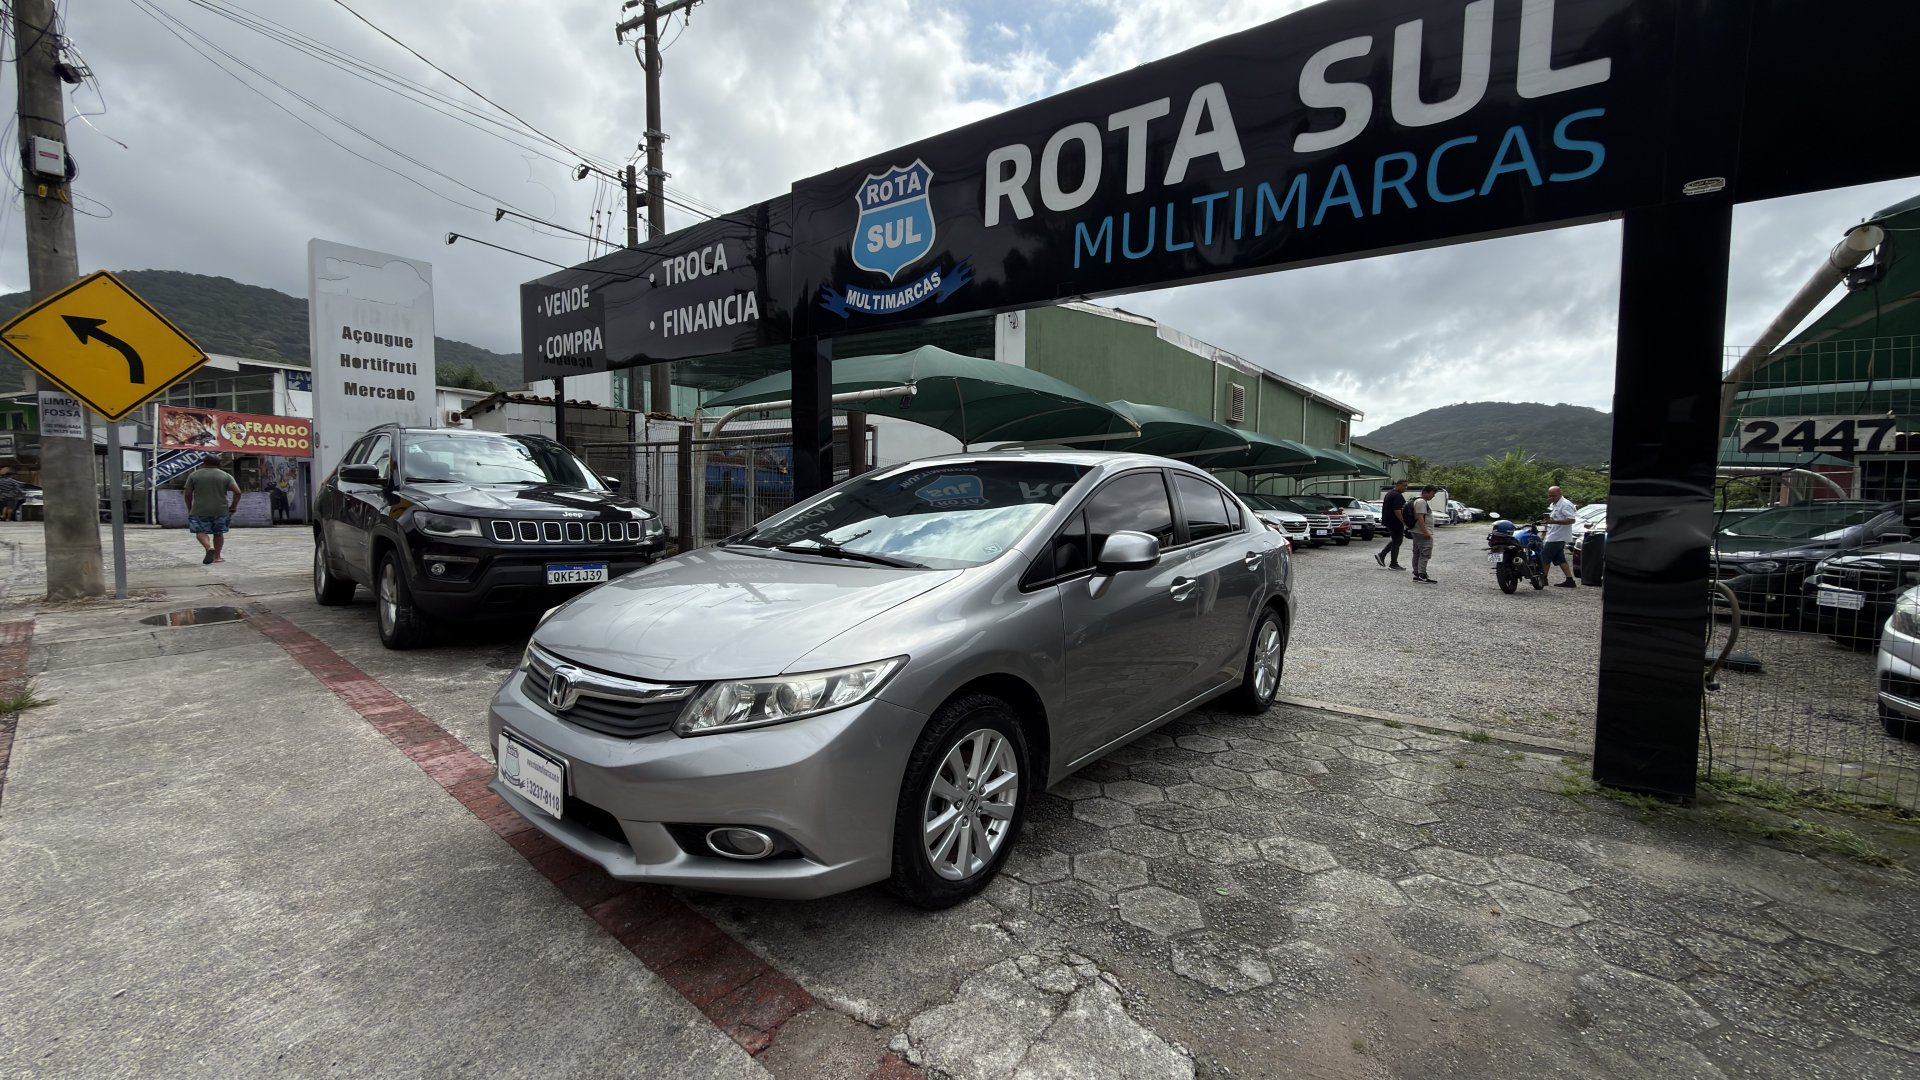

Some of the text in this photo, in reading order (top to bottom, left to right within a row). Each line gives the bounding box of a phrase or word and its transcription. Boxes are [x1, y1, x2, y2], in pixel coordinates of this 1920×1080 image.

[984, 0, 1612, 228] ROTA SUL
[866, 171, 922, 206] ROTA
[1073, 98, 1606, 269] MULTIMARCAS
[867, 216, 922, 253] SUL
[662, 243, 729, 287] TROCA
[544, 284, 590, 318] VENDE
[846, 271, 942, 310] MULTIMARCAS
[663, 290, 760, 338] FINANCIA
[342, 325, 414, 349] Açougue
[546, 326, 603, 359] COMPRA
[340, 353, 417, 376] Hortifruti
[43, 397, 80, 407] LIMPA
[344, 381, 416, 401] Mercado
[44, 408, 81, 418] FOSSA
[245, 421, 309, 437] FRANGO
[246, 435, 309, 449] ASSADO
[1742, 418, 1896, 453] 2447
[562, 511, 584, 519] Jeep
[553, 570, 602, 583] QKF1J39
[529, 780, 560, 812] 3237-8118
